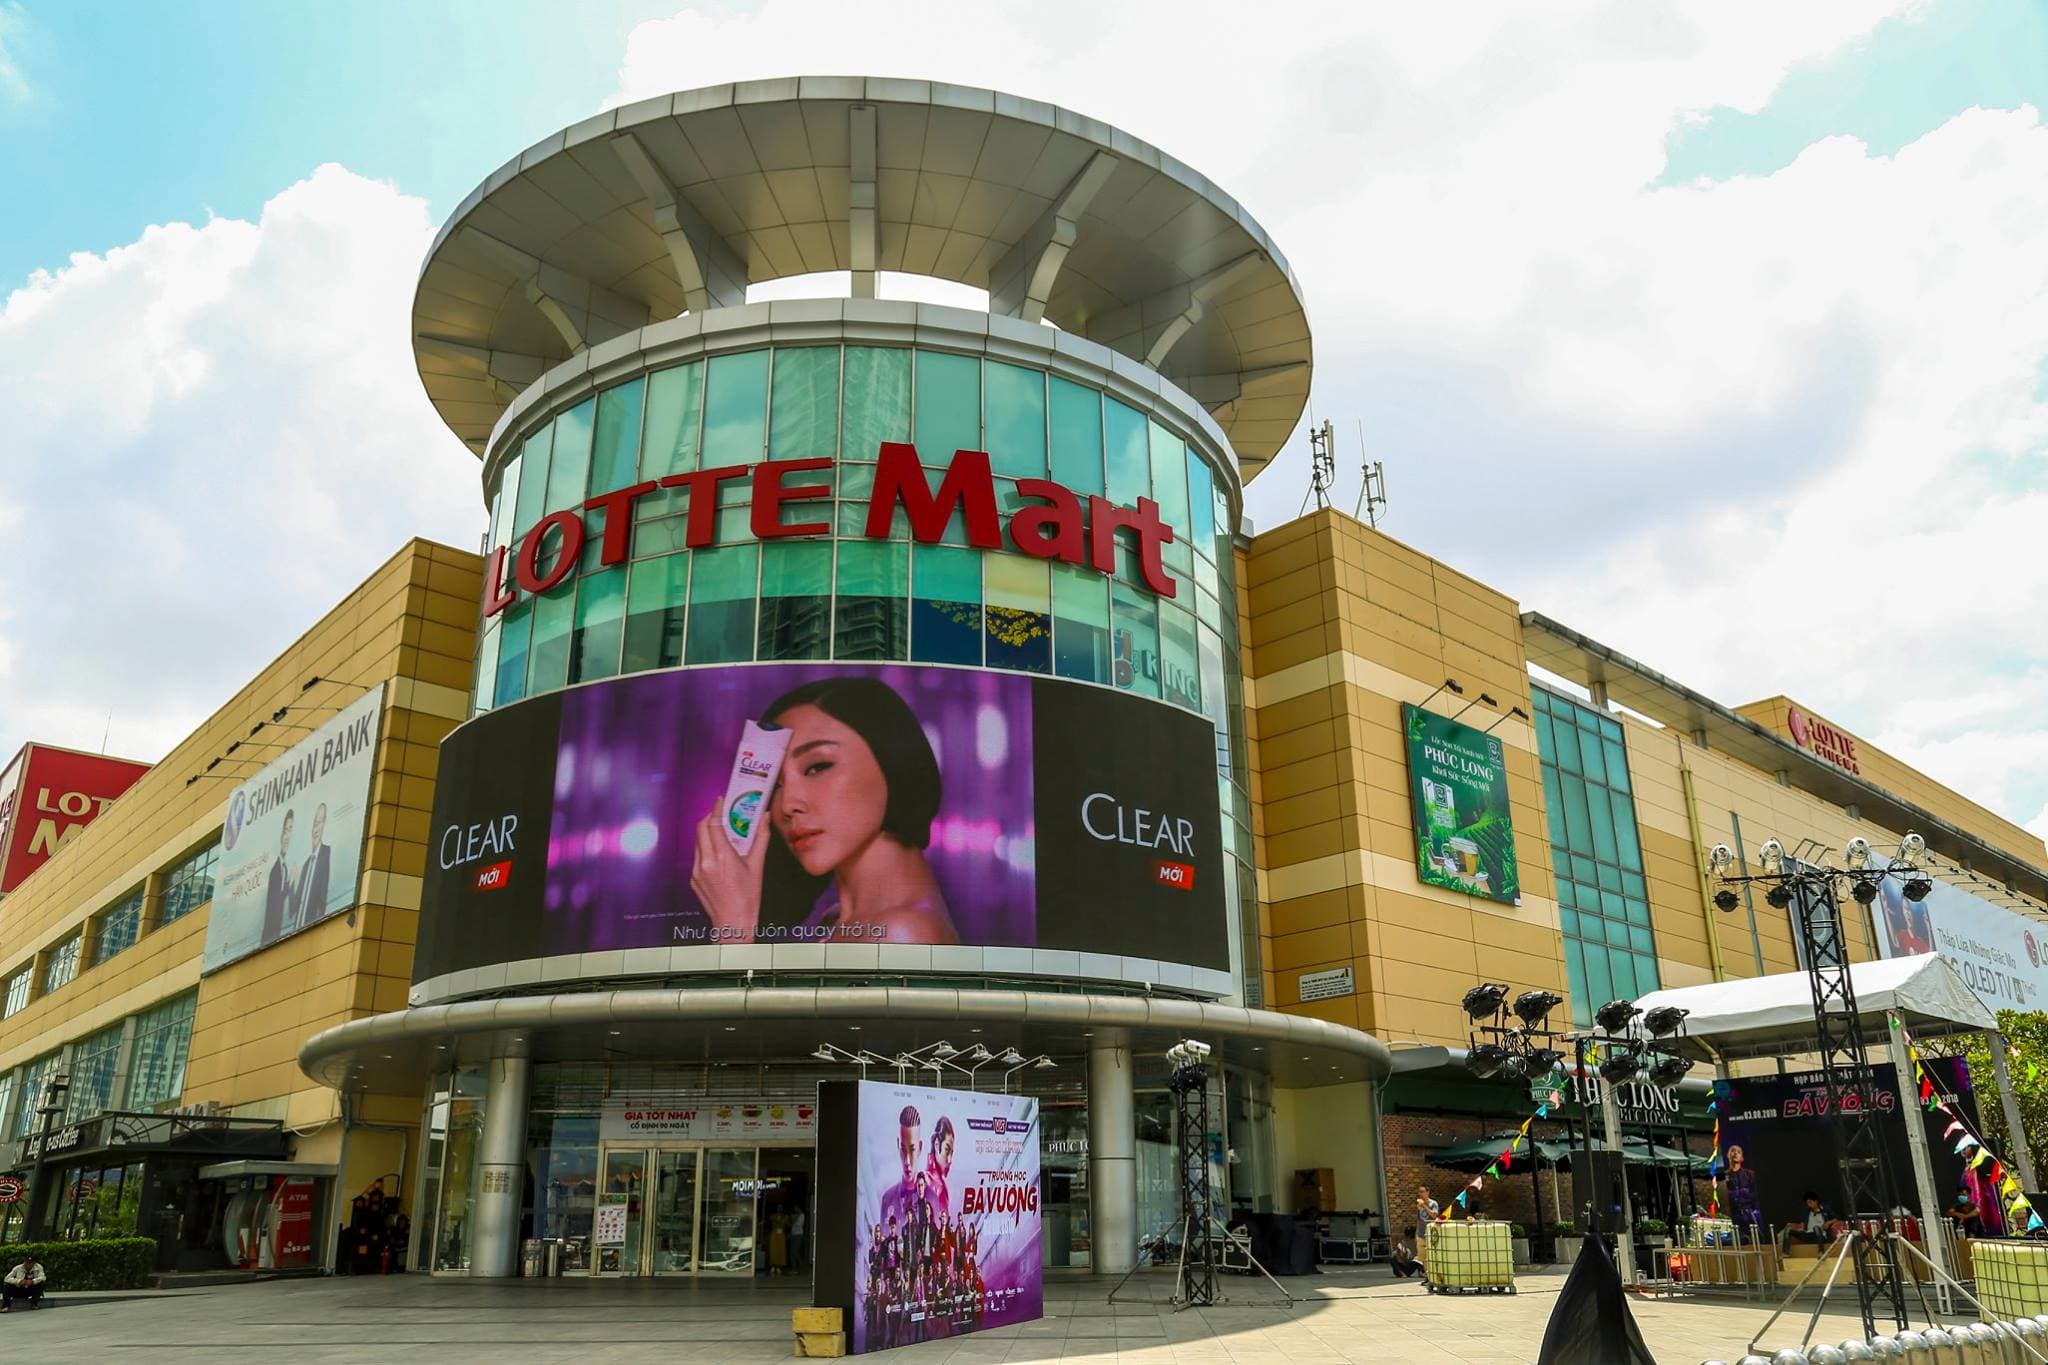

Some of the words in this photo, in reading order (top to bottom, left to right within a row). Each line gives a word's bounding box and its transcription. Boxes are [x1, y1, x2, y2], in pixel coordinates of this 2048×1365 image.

[483, 457, 833, 618] LOTTE
[864, 440, 1177, 599] Mart
[1808, 717, 1857, 761] LOTTE
[246, 749, 319, 826] SHINHAN
[321, 710, 374, 777] BANK
[741, 757, 771, 772] CLEAR
[1424, 744, 1459, 769] PHÚC
[1461, 758, 1494, 782] LONG
[440, 814, 518, 870] CLEAR
[1081, 792, 1195, 857] CLEAR
[478, 867, 500, 888] MỚI
[1160, 866, 1184, 883] MỚI
[673, 926, 706, 940] Như
[752, 922, 788, 938] luôn
[792, 926, 836, 941] quay
[840, 922, 864, 938] trở
[867, 923, 887, 941] lại
[1963, 960, 1996, 995] OLED
[1995, 971, 2012, 1000] TV
[1629, 1080, 1680, 1112] LONG
